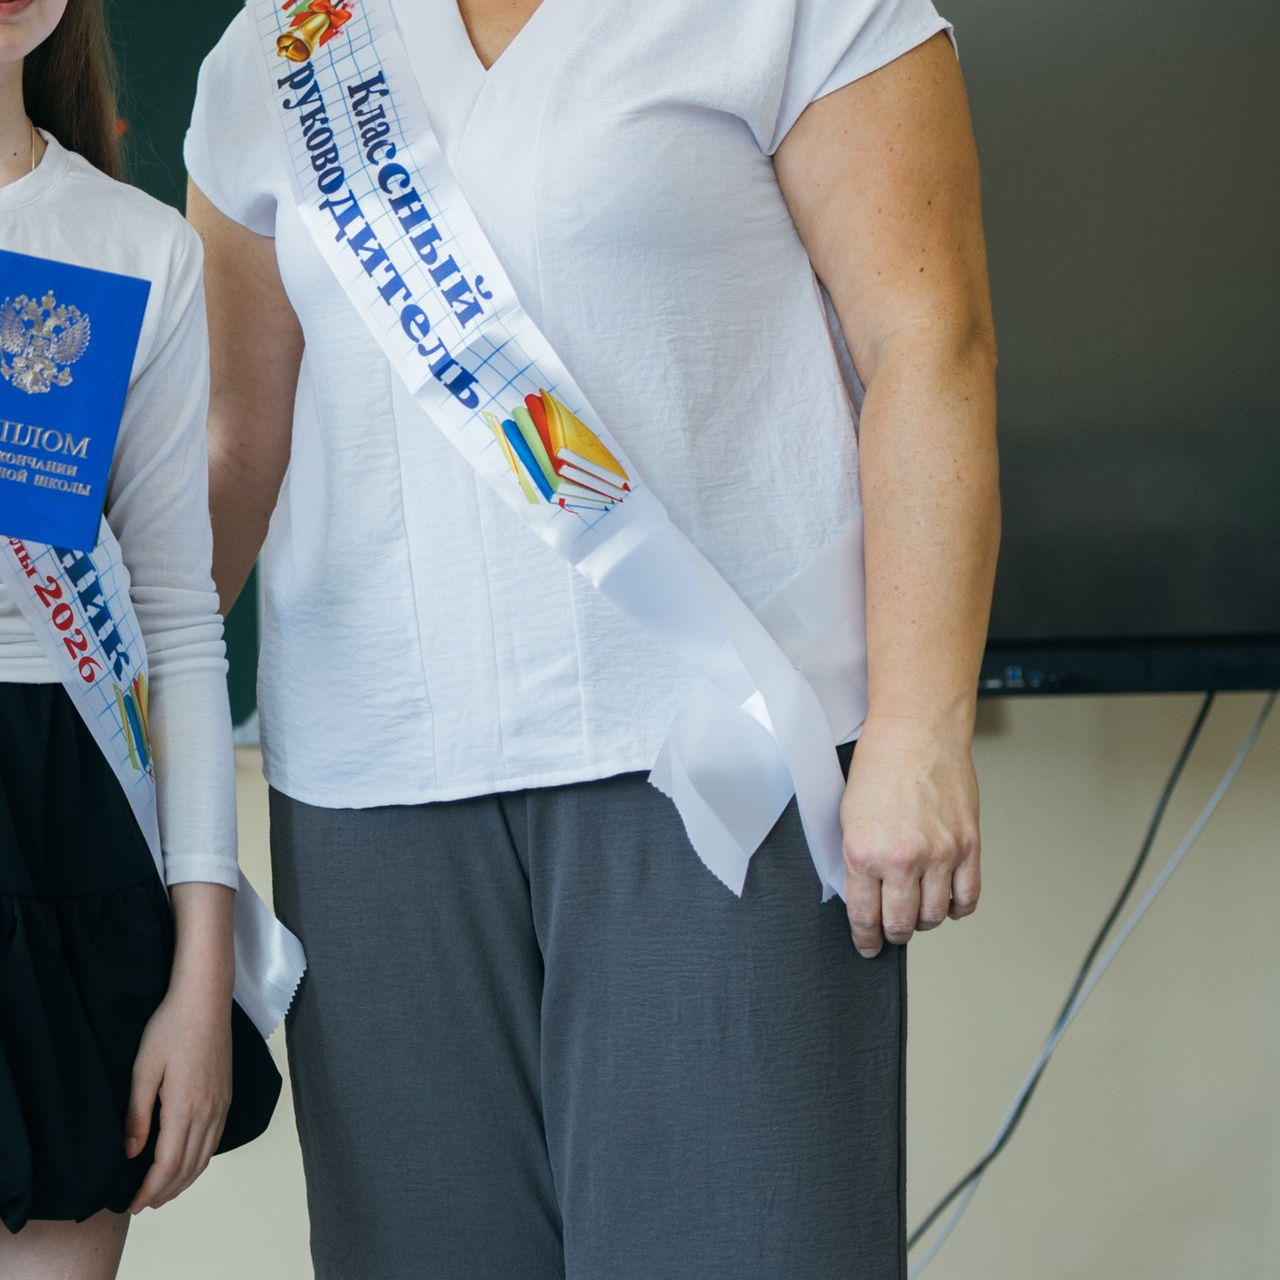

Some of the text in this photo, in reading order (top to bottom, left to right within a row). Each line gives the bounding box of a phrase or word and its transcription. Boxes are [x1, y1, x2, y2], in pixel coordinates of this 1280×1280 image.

[276, 61, 480, 410] руководитель
[347, 71, 493, 330] Классный
[34, 474, 91, 496] ШКОЛЫ
[33, 575, 103, 684] 2026
